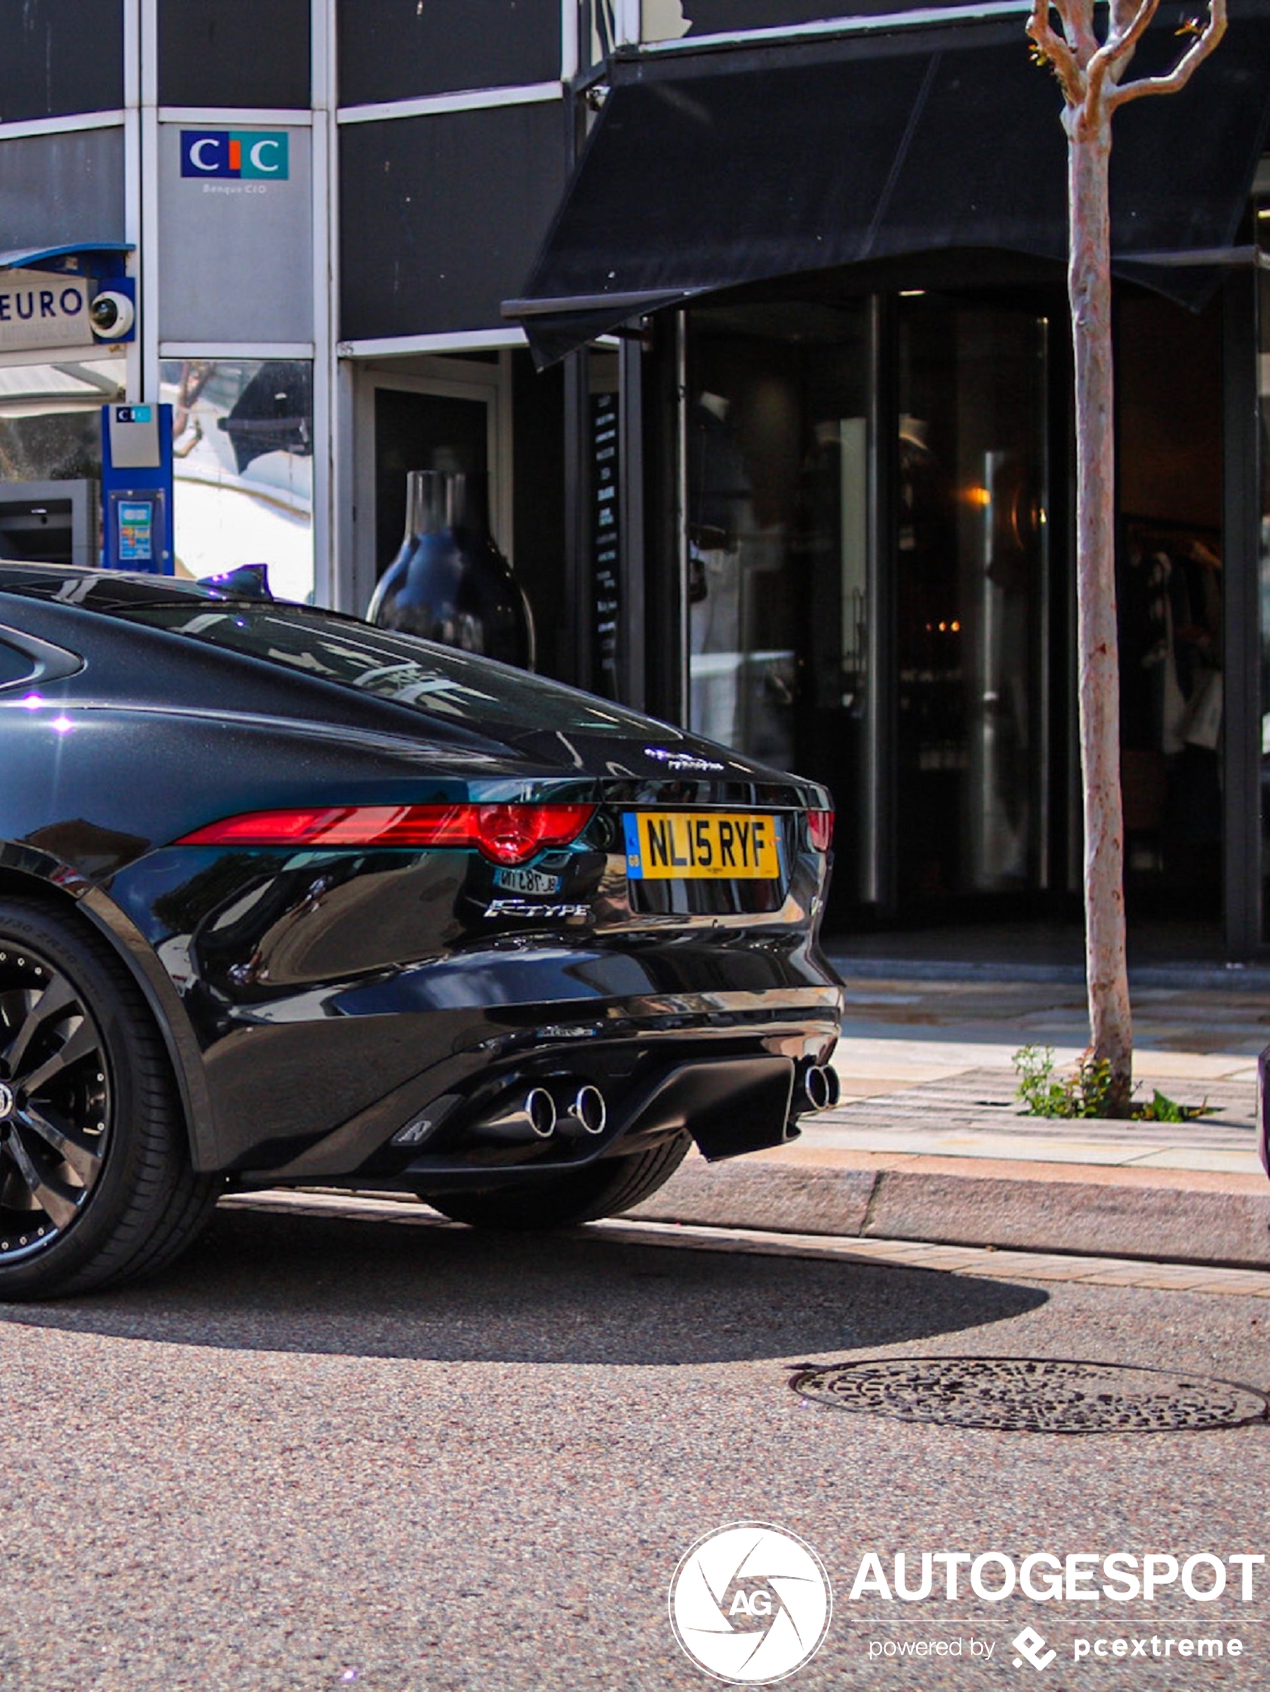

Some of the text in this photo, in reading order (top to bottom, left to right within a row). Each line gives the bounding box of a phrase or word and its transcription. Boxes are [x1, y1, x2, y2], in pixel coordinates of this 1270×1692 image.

[189, 138, 279, 171] CIC
[647, 819, 766, 868] NL15 RYF
